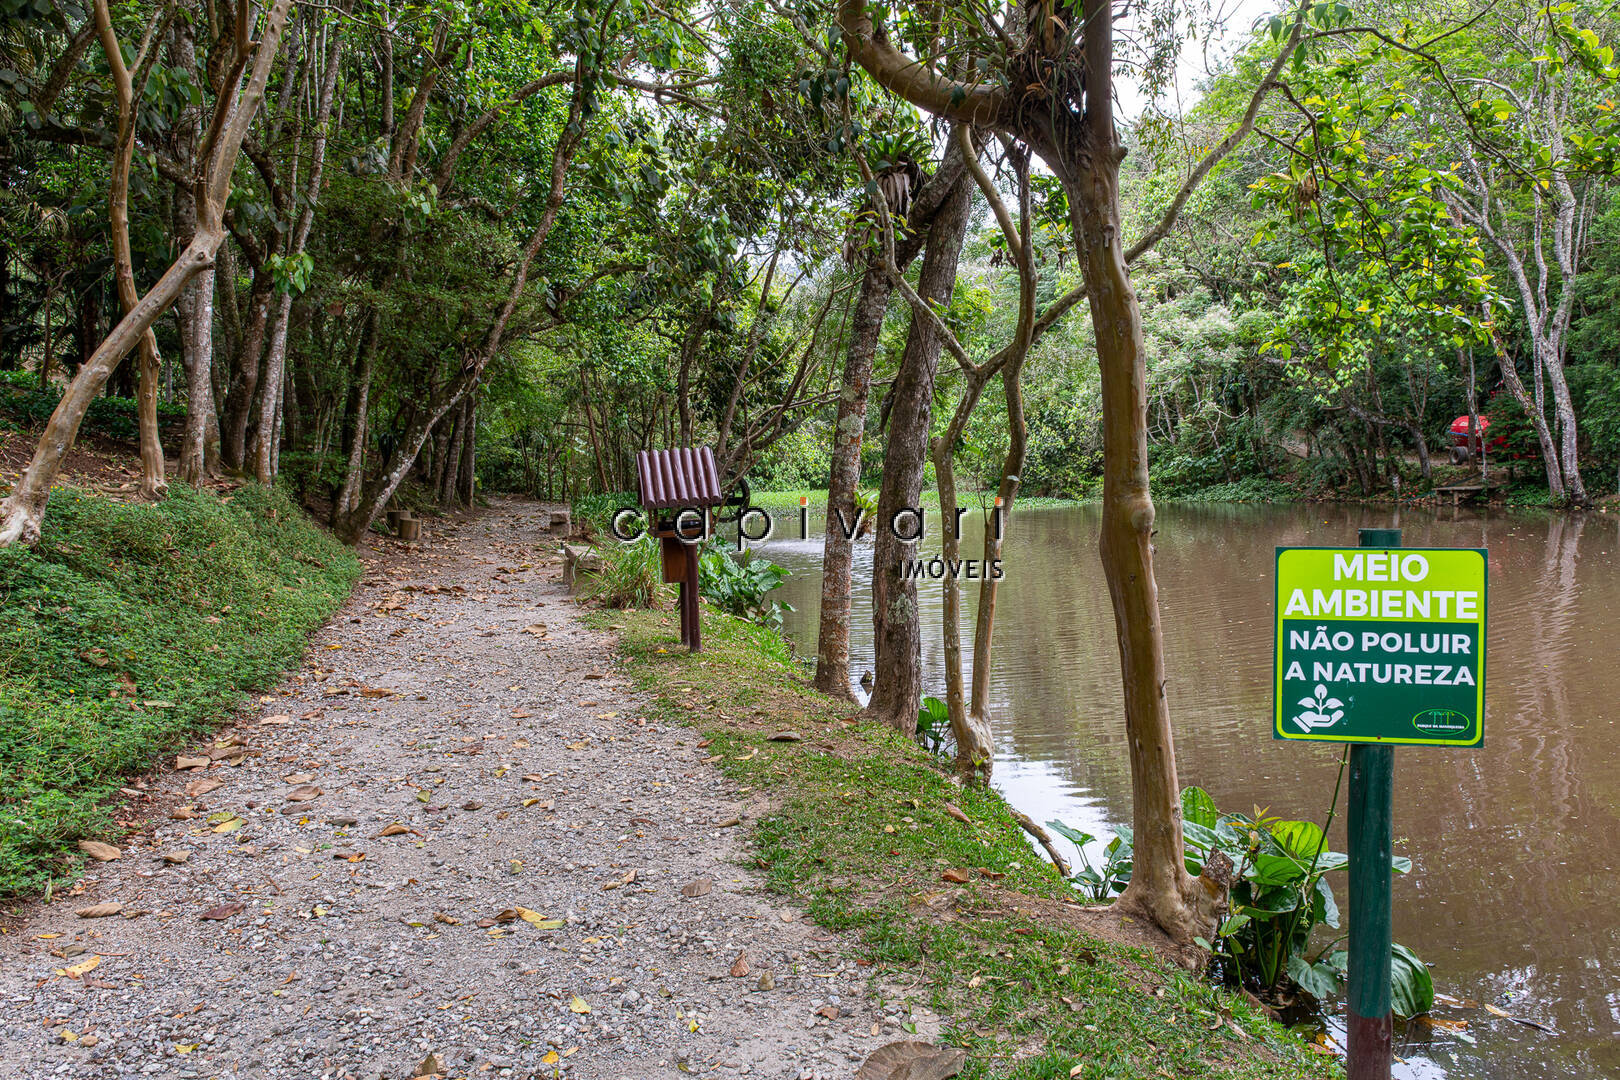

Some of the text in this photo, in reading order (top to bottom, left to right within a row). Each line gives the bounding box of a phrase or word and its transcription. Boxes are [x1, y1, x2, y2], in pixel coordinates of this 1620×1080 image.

[1333, 553, 1429, 582] MEIO
[1284, 588, 1478, 619] AMBIENTE
[1289, 626, 1471, 654] NÃO POLUIR
[1284, 661, 1475, 686] A NATUREZA
